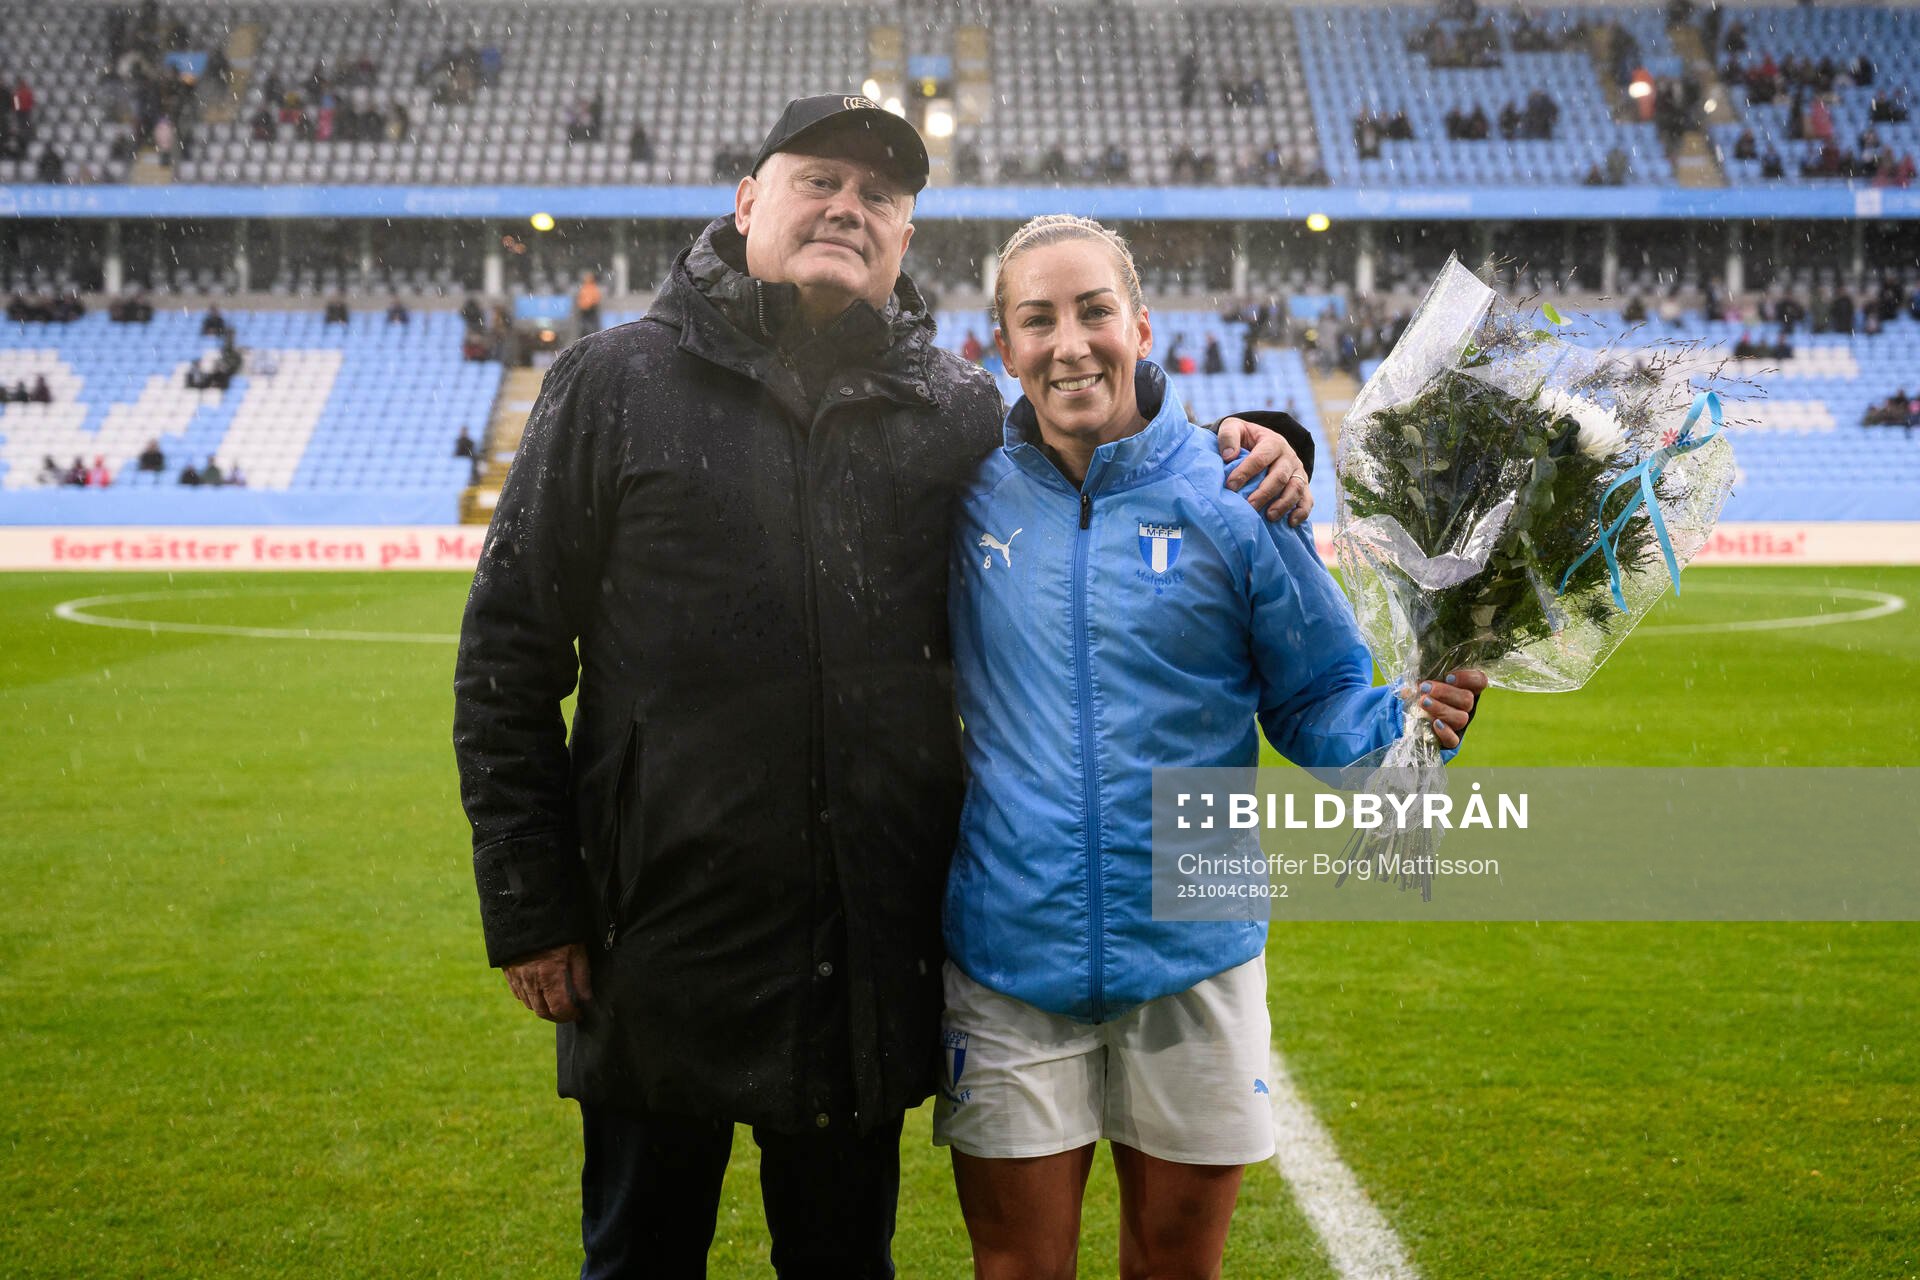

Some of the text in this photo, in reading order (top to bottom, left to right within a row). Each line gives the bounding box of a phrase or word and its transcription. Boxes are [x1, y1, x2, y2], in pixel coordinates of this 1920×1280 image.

[52, 535, 239, 561] fortsätter
[253, 535, 364, 561] festen
[381, 533, 421, 568] på
[983, 555, 992, 569] 8
